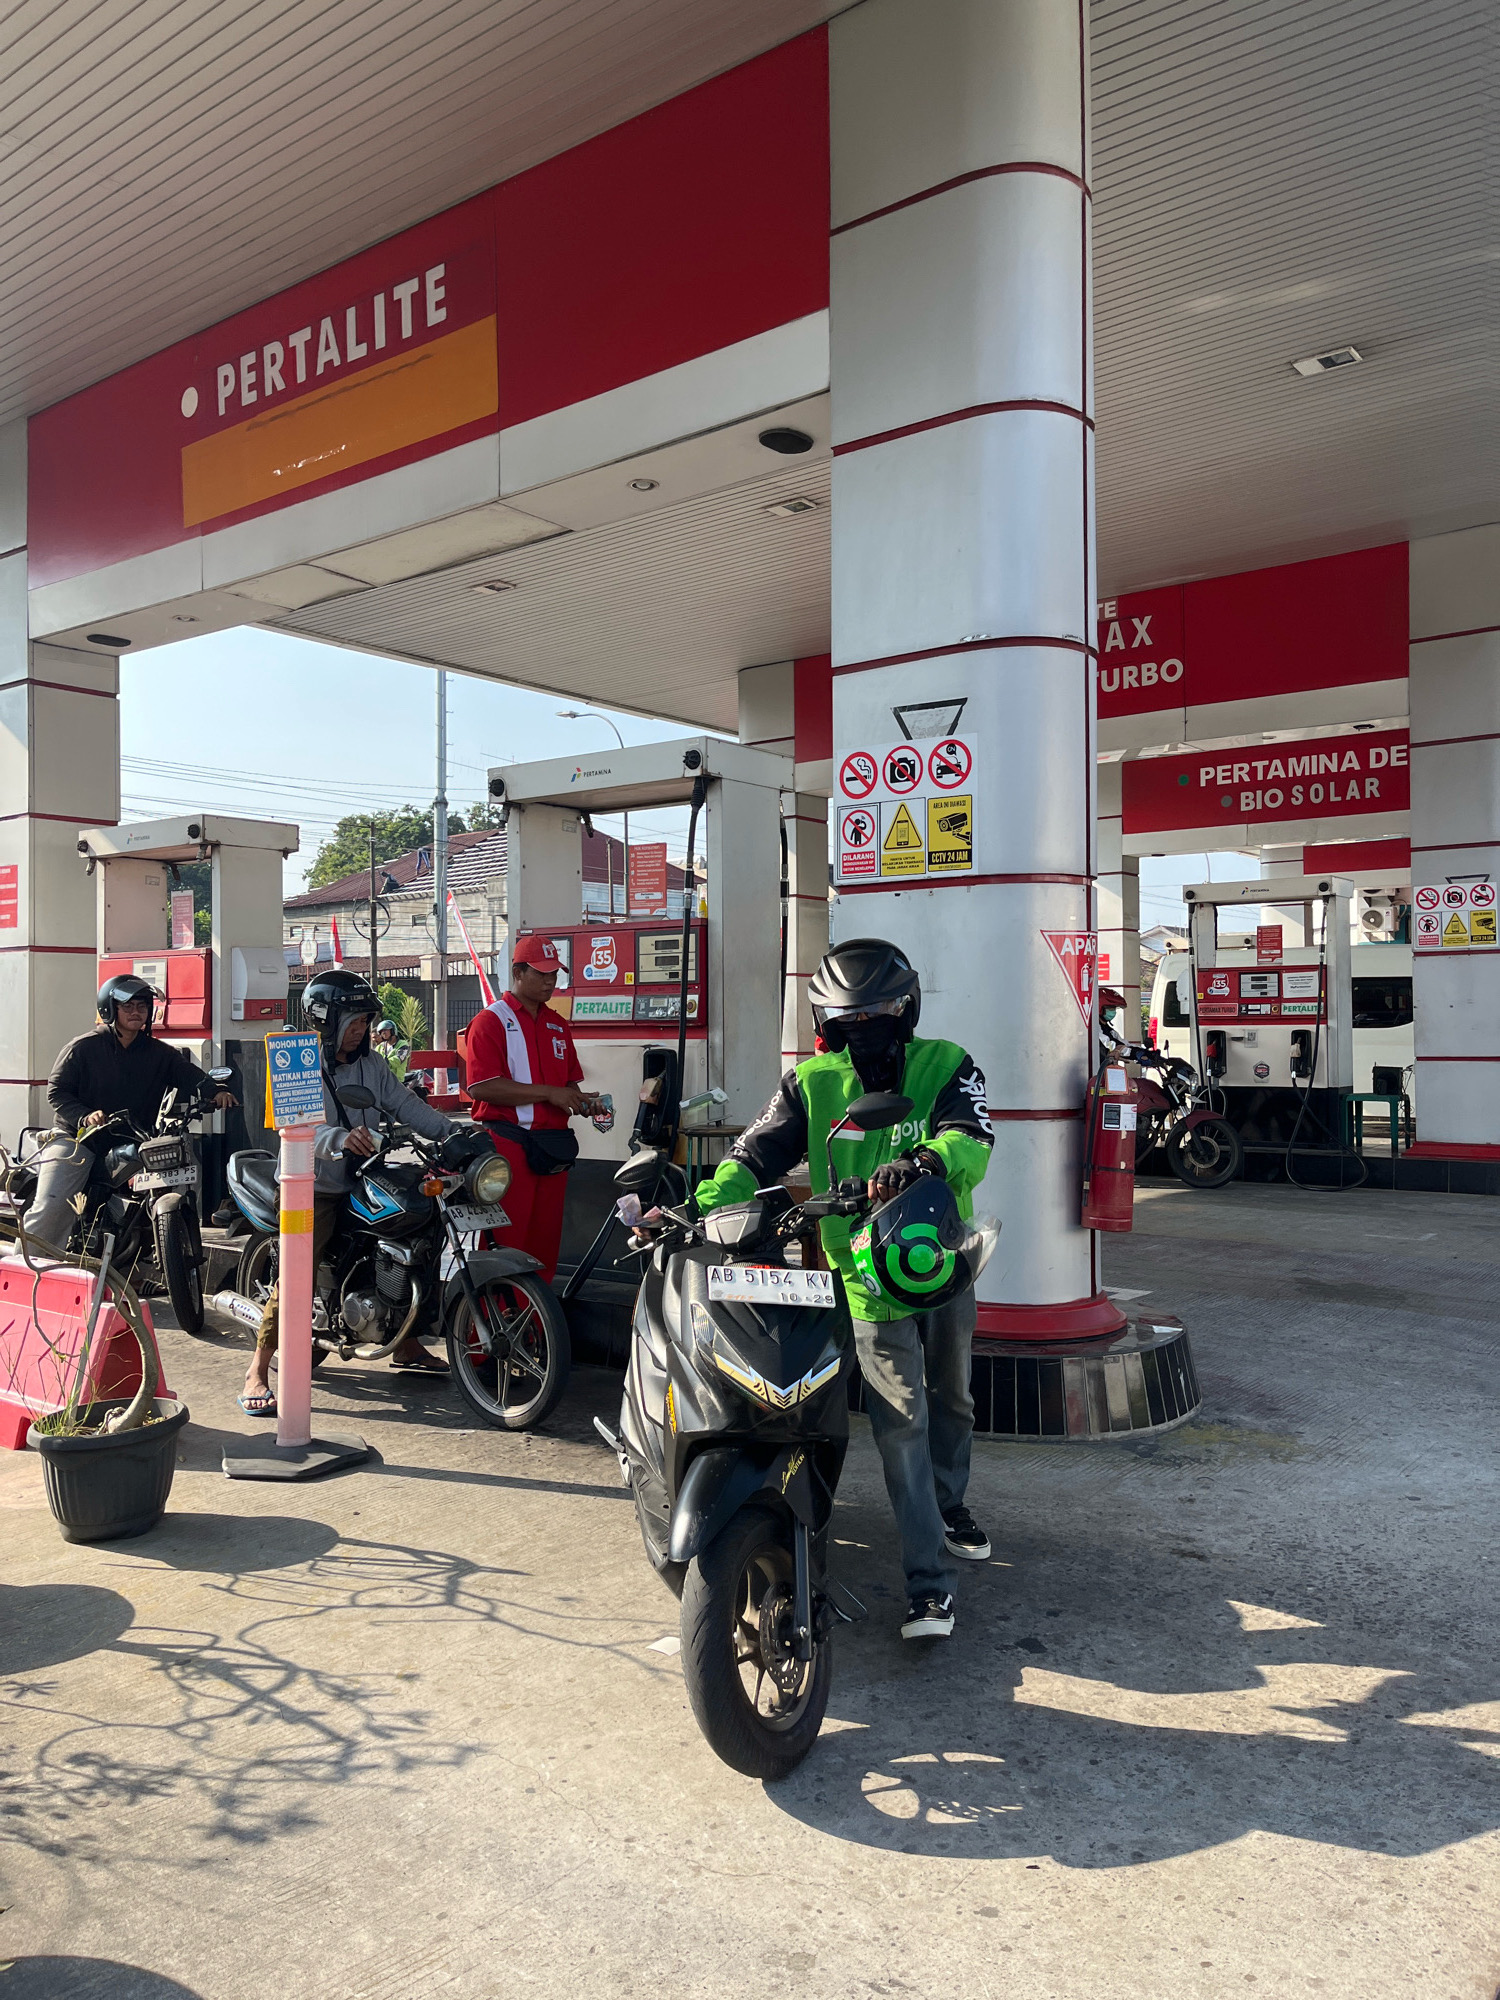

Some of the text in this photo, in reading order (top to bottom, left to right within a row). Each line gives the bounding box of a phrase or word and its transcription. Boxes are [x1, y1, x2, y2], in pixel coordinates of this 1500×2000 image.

[216, 262, 448, 417] PERTALITE
[1097, 658, 1184, 693] URBO
[1200, 744, 1408, 787] PERTAMINA DE
[583, 768, 612, 778] PERTAMINA
[1240, 777, 1381, 812] BIO SOLAR
[843, 852, 875, 861] DILARANG
[931, 850, 968, 863] CCTV 24 JAM
[1060, 937, 1097, 956] APAR
[592, 949, 612, 966] 135
[575, 1001, 632, 1014] PERTALITE
[269, 1037, 318, 1050] MOHON MAAF
[272, 1069, 321, 1083] MATIKAN MESIN
[184, 1166, 196, 1174] PS
[450, 1207, 465, 1219] AB
[719, 1215, 745, 1223] HONDA
[711, 1267, 829, 1288] AB 5154 KV
